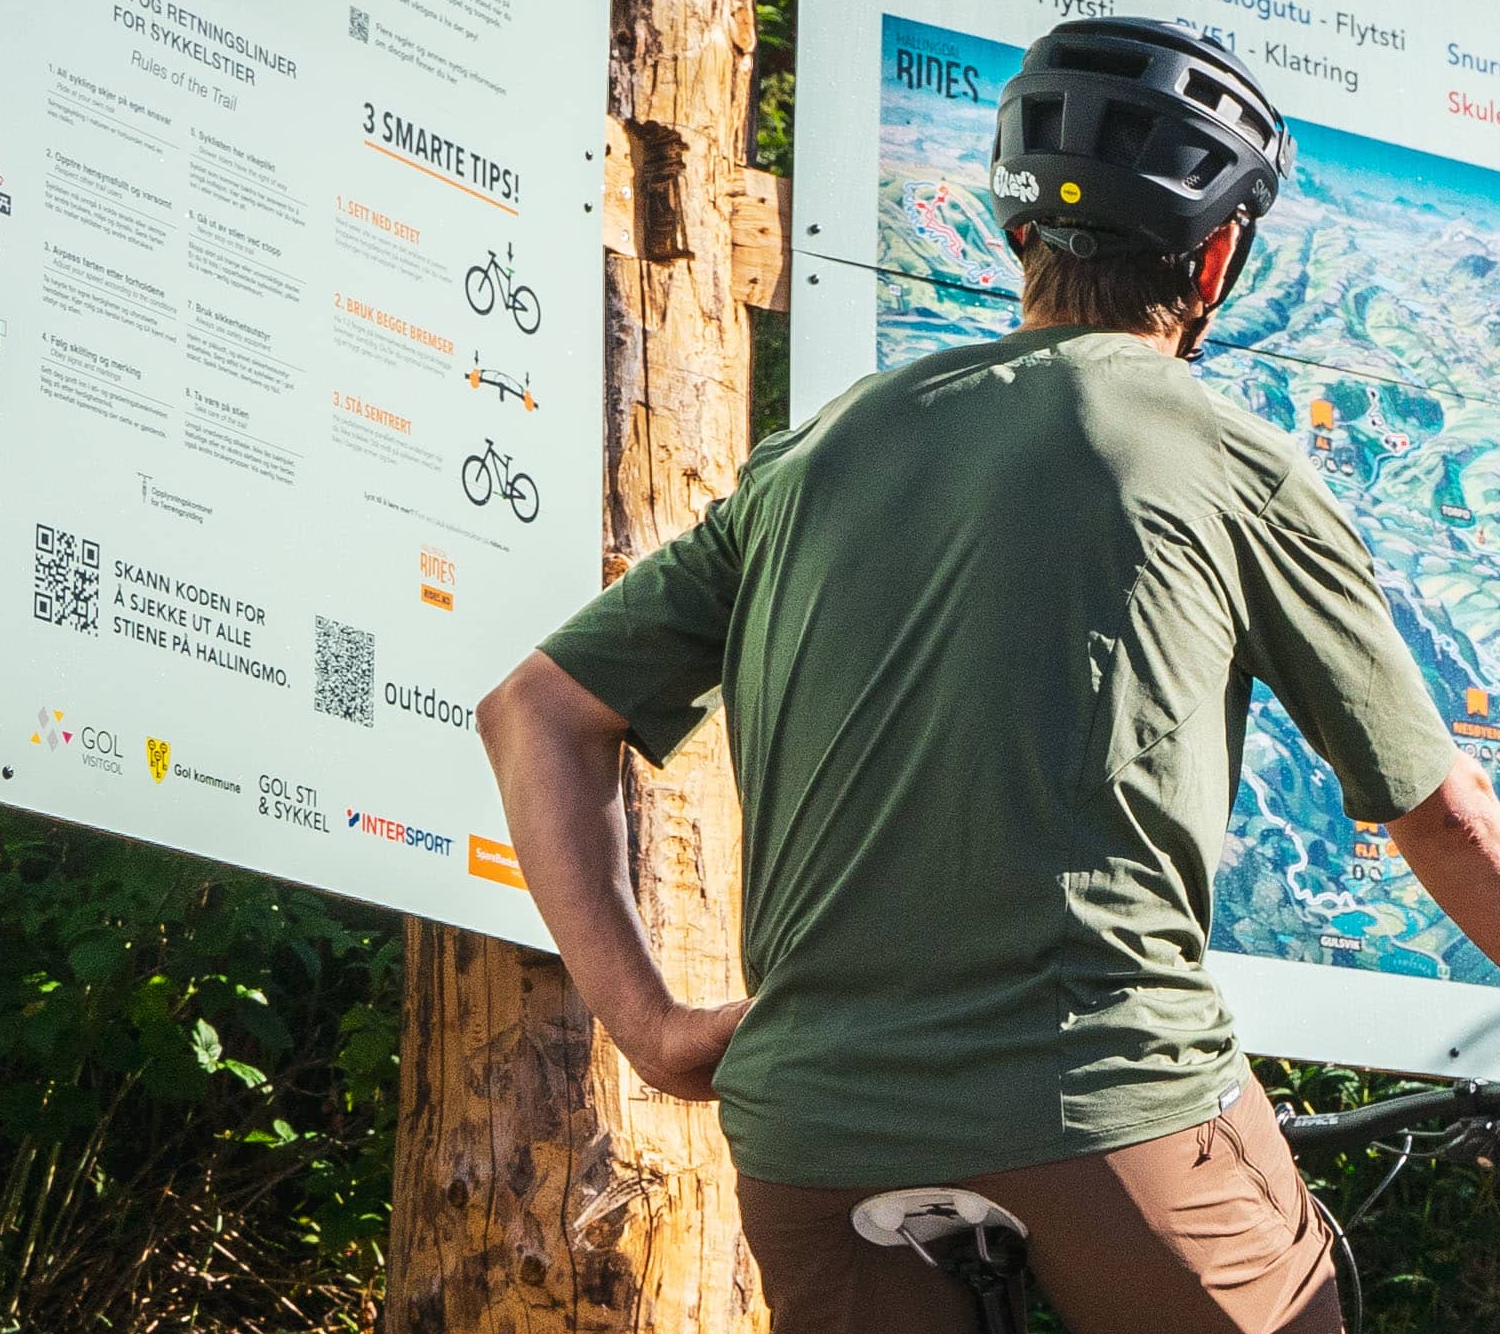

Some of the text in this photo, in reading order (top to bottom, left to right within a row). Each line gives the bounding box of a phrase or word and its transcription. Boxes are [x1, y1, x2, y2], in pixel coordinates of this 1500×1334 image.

[113, 5, 255, 86] FOR SYKKELSTIER
[167, 2, 297, 79] RETNINGSLINJER
[1176, 17, 1237, 54] V51
[1265, 42, 1359, 93] Klatring
[1336, 13, 1406, 52] Flytsti
[131, 50, 238, 112] Rules of the Trail
[896, 48, 980, 104] RIDES
[363, 102, 519, 203] 3 SMARTE TIPS!
[337, 195, 421, 245] 1. SETT NED SETET
[335, 293, 454, 355] 2. BRUK BEGGE BREMSER
[333, 391, 343, 408] 3.
[364, 404, 412, 436] SENTRERT
[114, 560, 266, 627] SKANN KODEN FOR
[114, 583, 252, 648] Å SJEKKE UT ALLE
[113, 617, 291, 689] STIENE PÅ HALLINGMO.
[385, 681, 481, 735] outdoor
[81, 726, 124, 759] GOL
[82, 753, 124, 776] VISITGOL
[174, 763, 242, 794] Gol kommune
[259, 774, 317, 808] GOL STI
[258, 796, 331, 834] & SYKKEL
[361, 813, 455, 857] INTERSPORT
